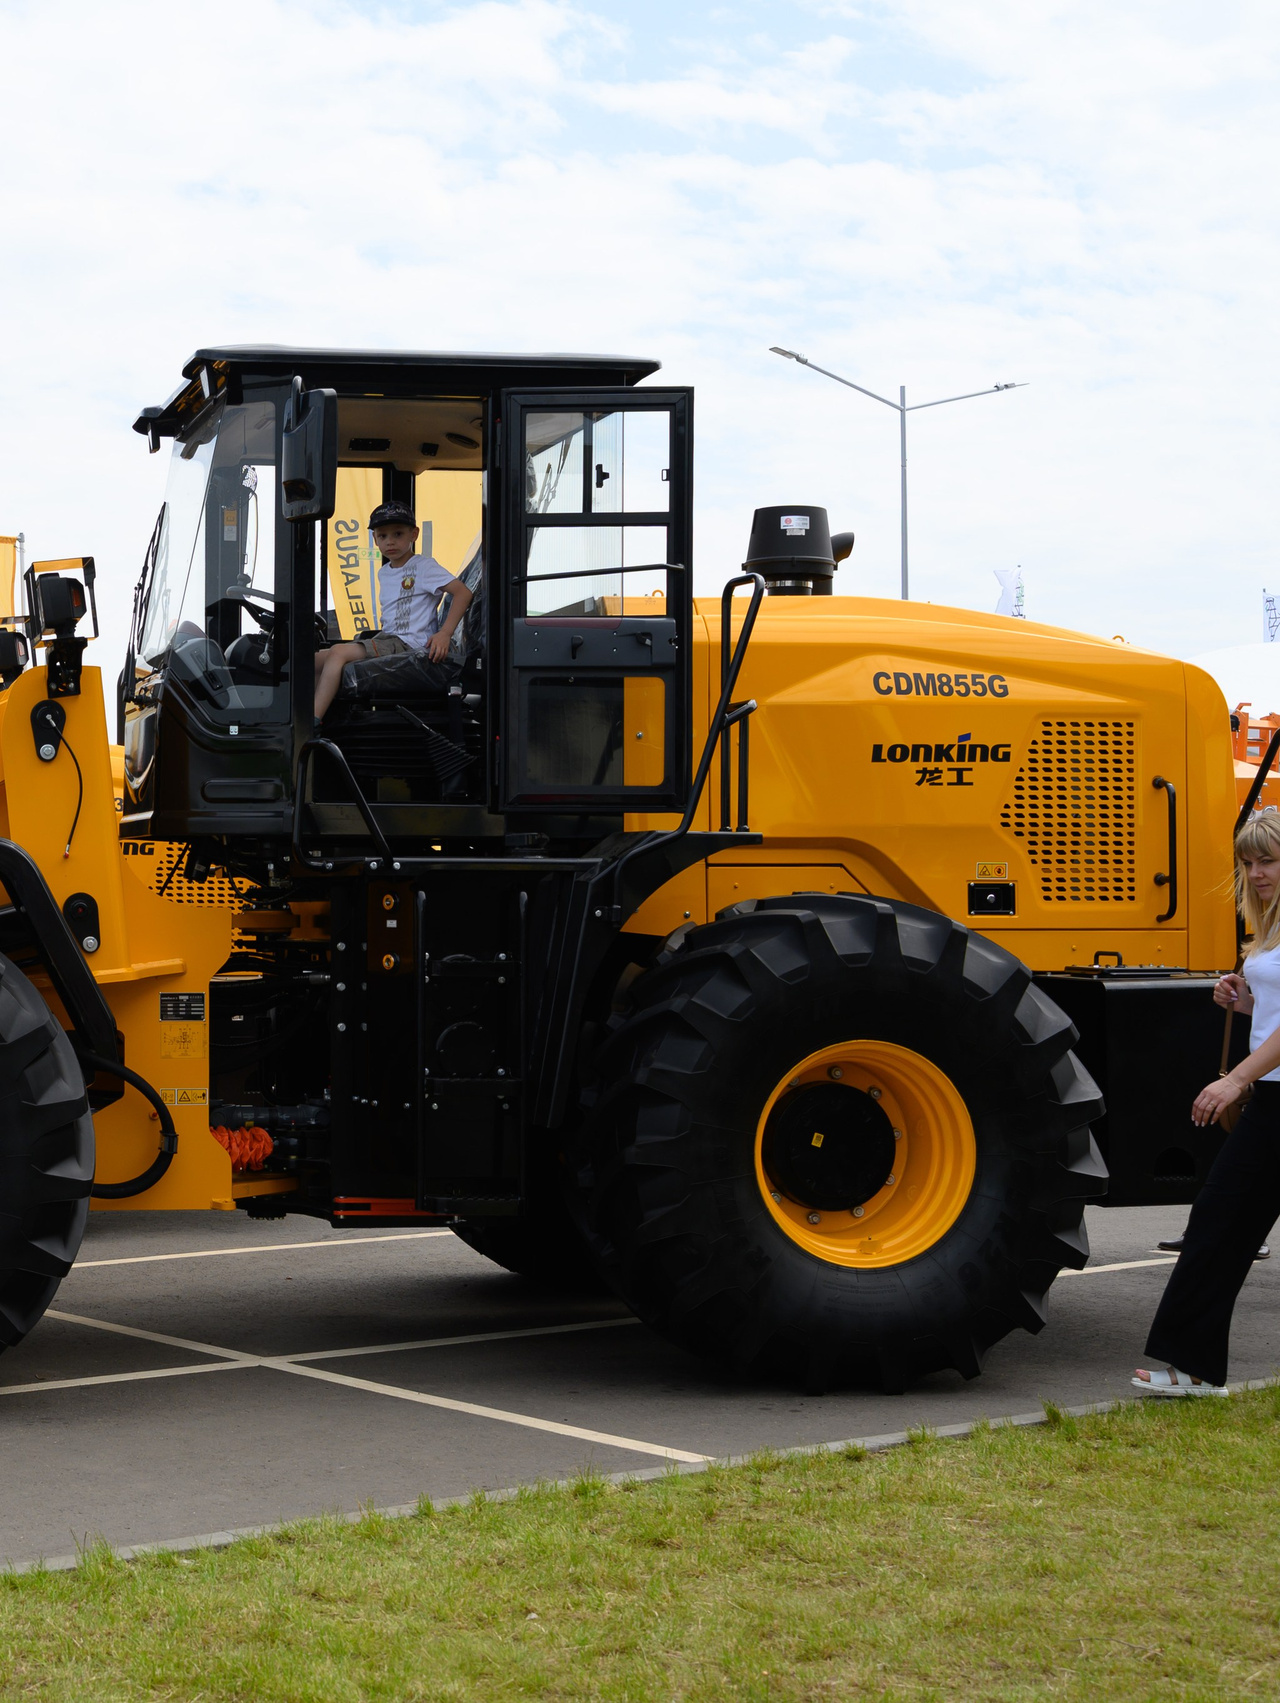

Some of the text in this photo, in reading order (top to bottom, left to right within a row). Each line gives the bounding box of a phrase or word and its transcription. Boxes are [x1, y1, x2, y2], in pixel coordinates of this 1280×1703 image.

[872, 671, 1010, 698] CDM855G
[871, 732, 1012, 763] LONKING
[914, 766, 974, 787] 龙工
